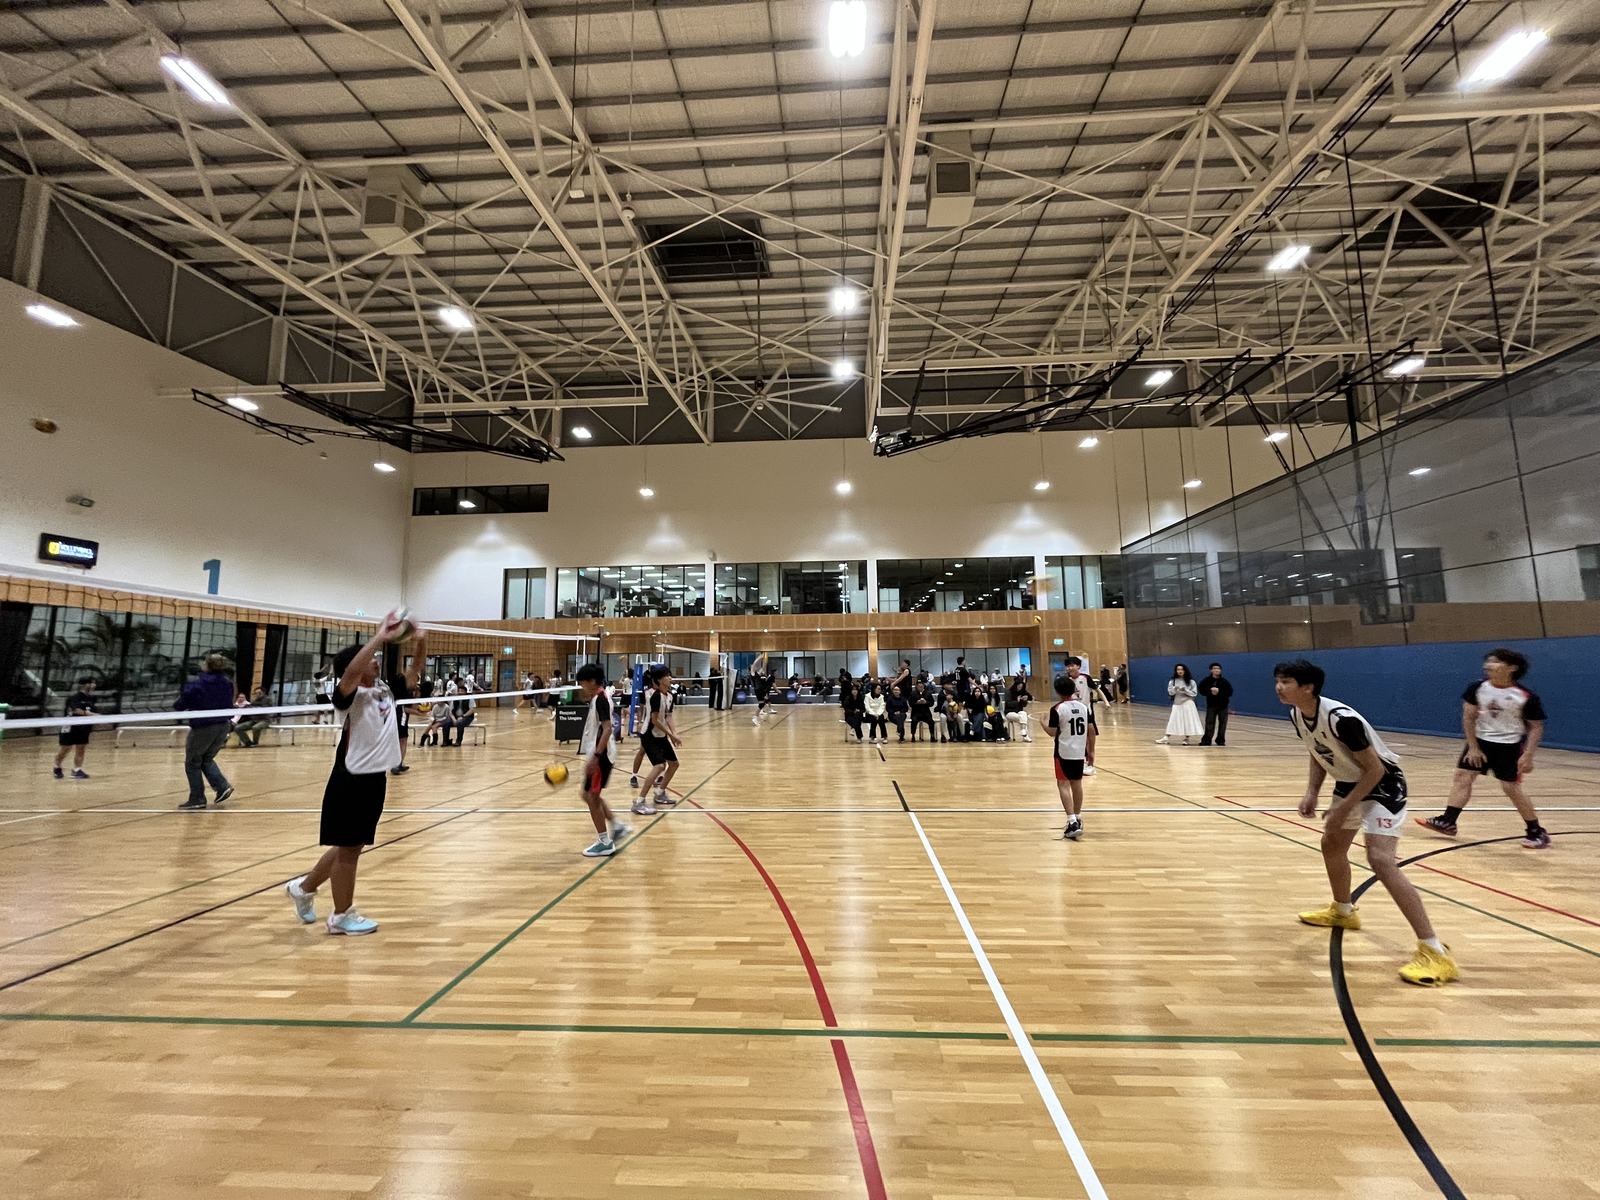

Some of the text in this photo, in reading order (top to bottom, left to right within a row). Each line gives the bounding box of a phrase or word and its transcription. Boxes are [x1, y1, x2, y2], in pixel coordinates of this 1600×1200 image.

[203, 559, 221, 594] 1
[1068, 716, 1085, 736] 16
[1376, 817, 1392, 828] 13
